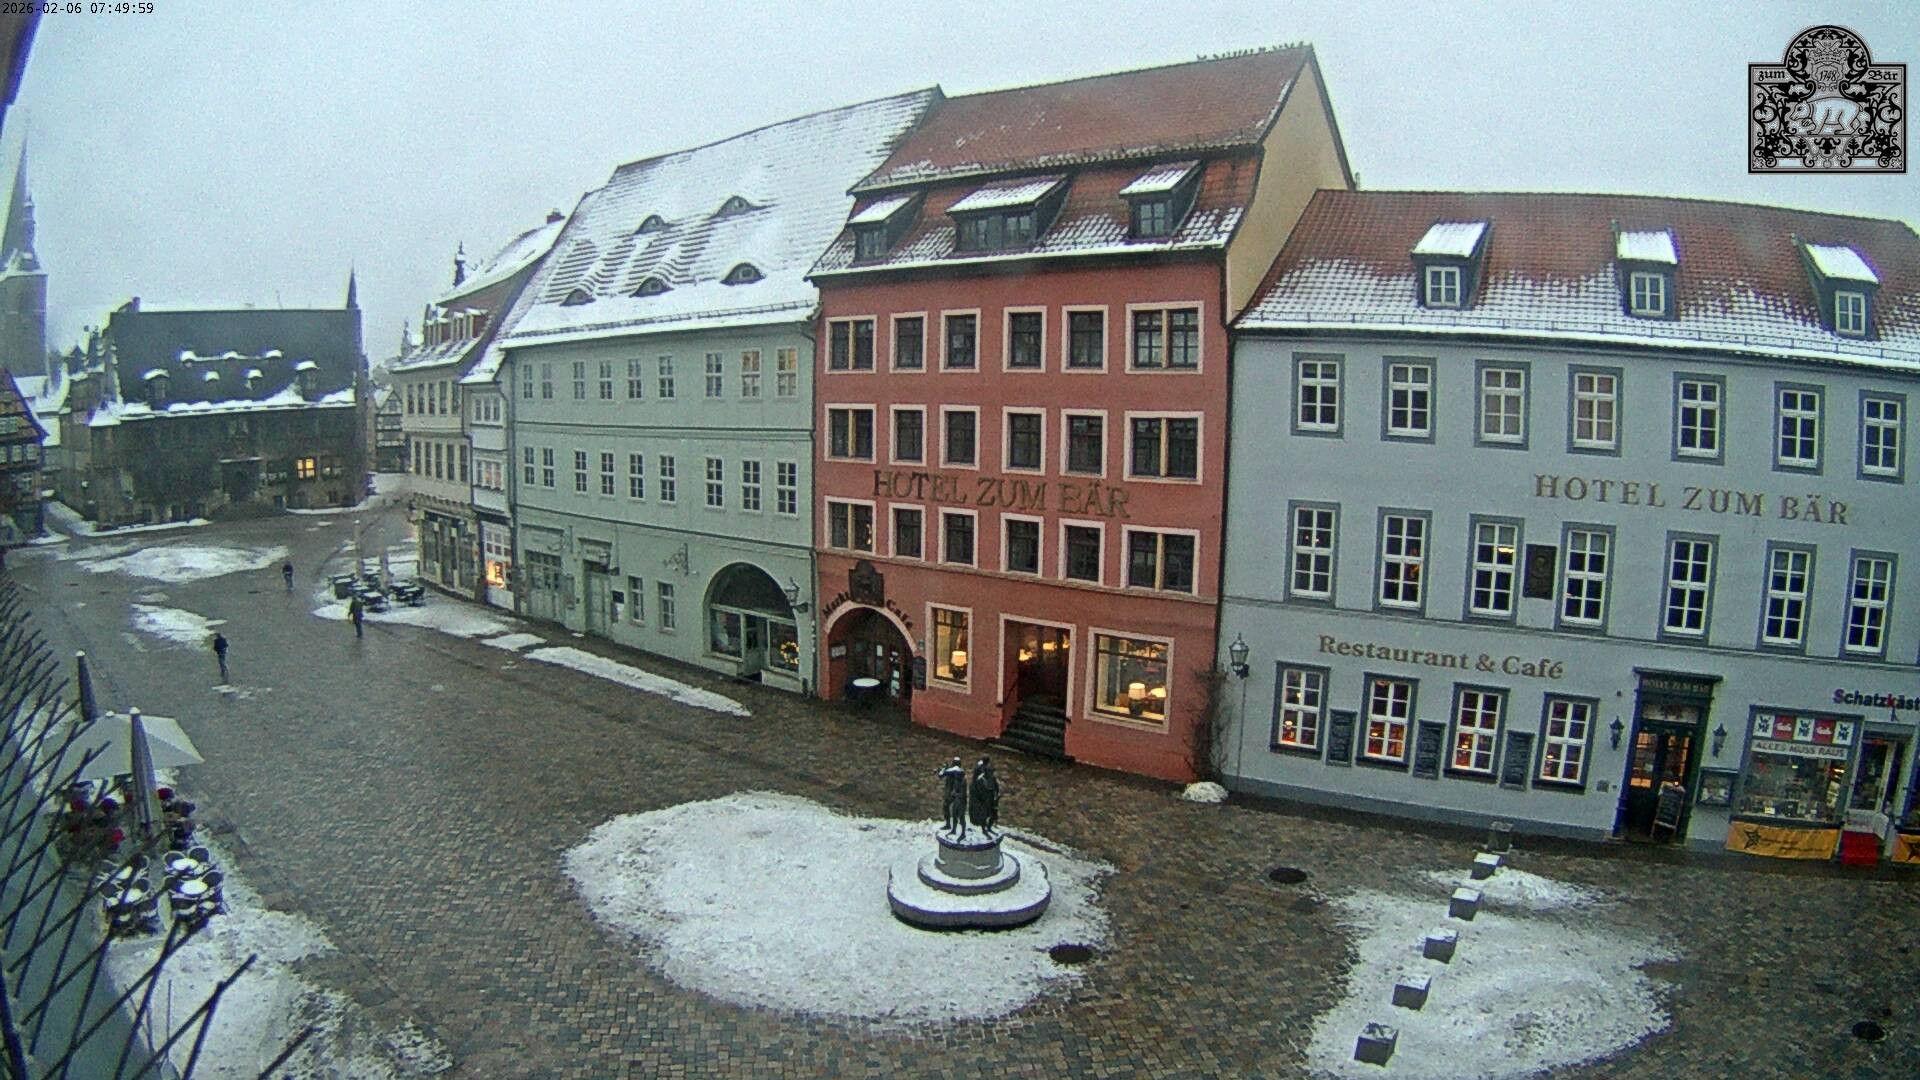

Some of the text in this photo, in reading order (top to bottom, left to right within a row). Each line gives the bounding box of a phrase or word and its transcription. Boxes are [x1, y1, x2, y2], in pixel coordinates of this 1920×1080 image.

[873, 470, 1130, 518] HOTEL ZUM BÄR
[1535, 473, 1848, 525] HOTEL ZUM BÄR
[1319, 635, 1563, 680] Restaurant & Café
